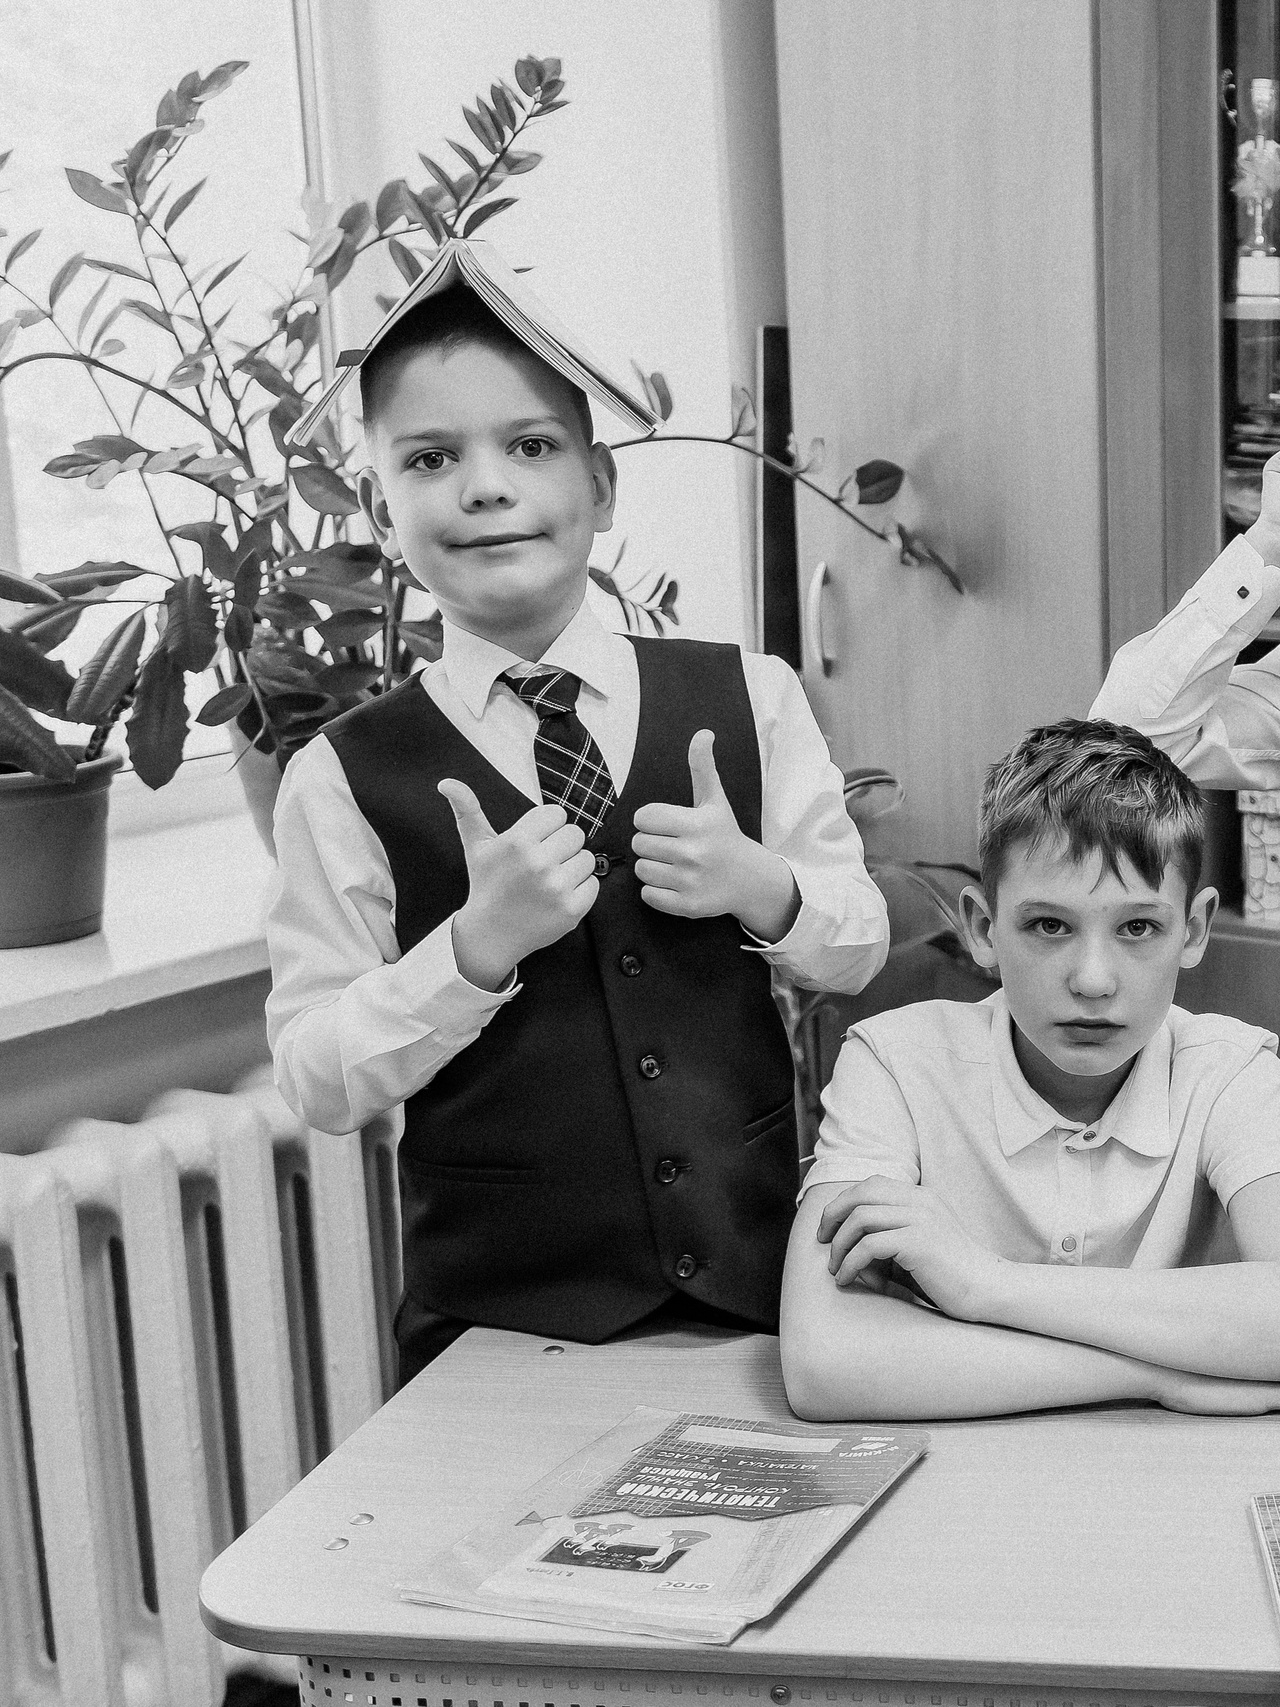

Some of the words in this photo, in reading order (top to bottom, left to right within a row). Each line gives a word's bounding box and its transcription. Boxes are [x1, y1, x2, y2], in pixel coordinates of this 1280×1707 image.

[700, 1455, 715, 1464] 3
[736, 1458, 818, 1470] МАТЕМАТИКА
[703, 1480, 790, 1493] КОНТРОЛЬ
[614, 1481, 781, 1508] ТЕМАТИЧЕСКИЙ
[661, 1581, 709, 1589] ФГОС
